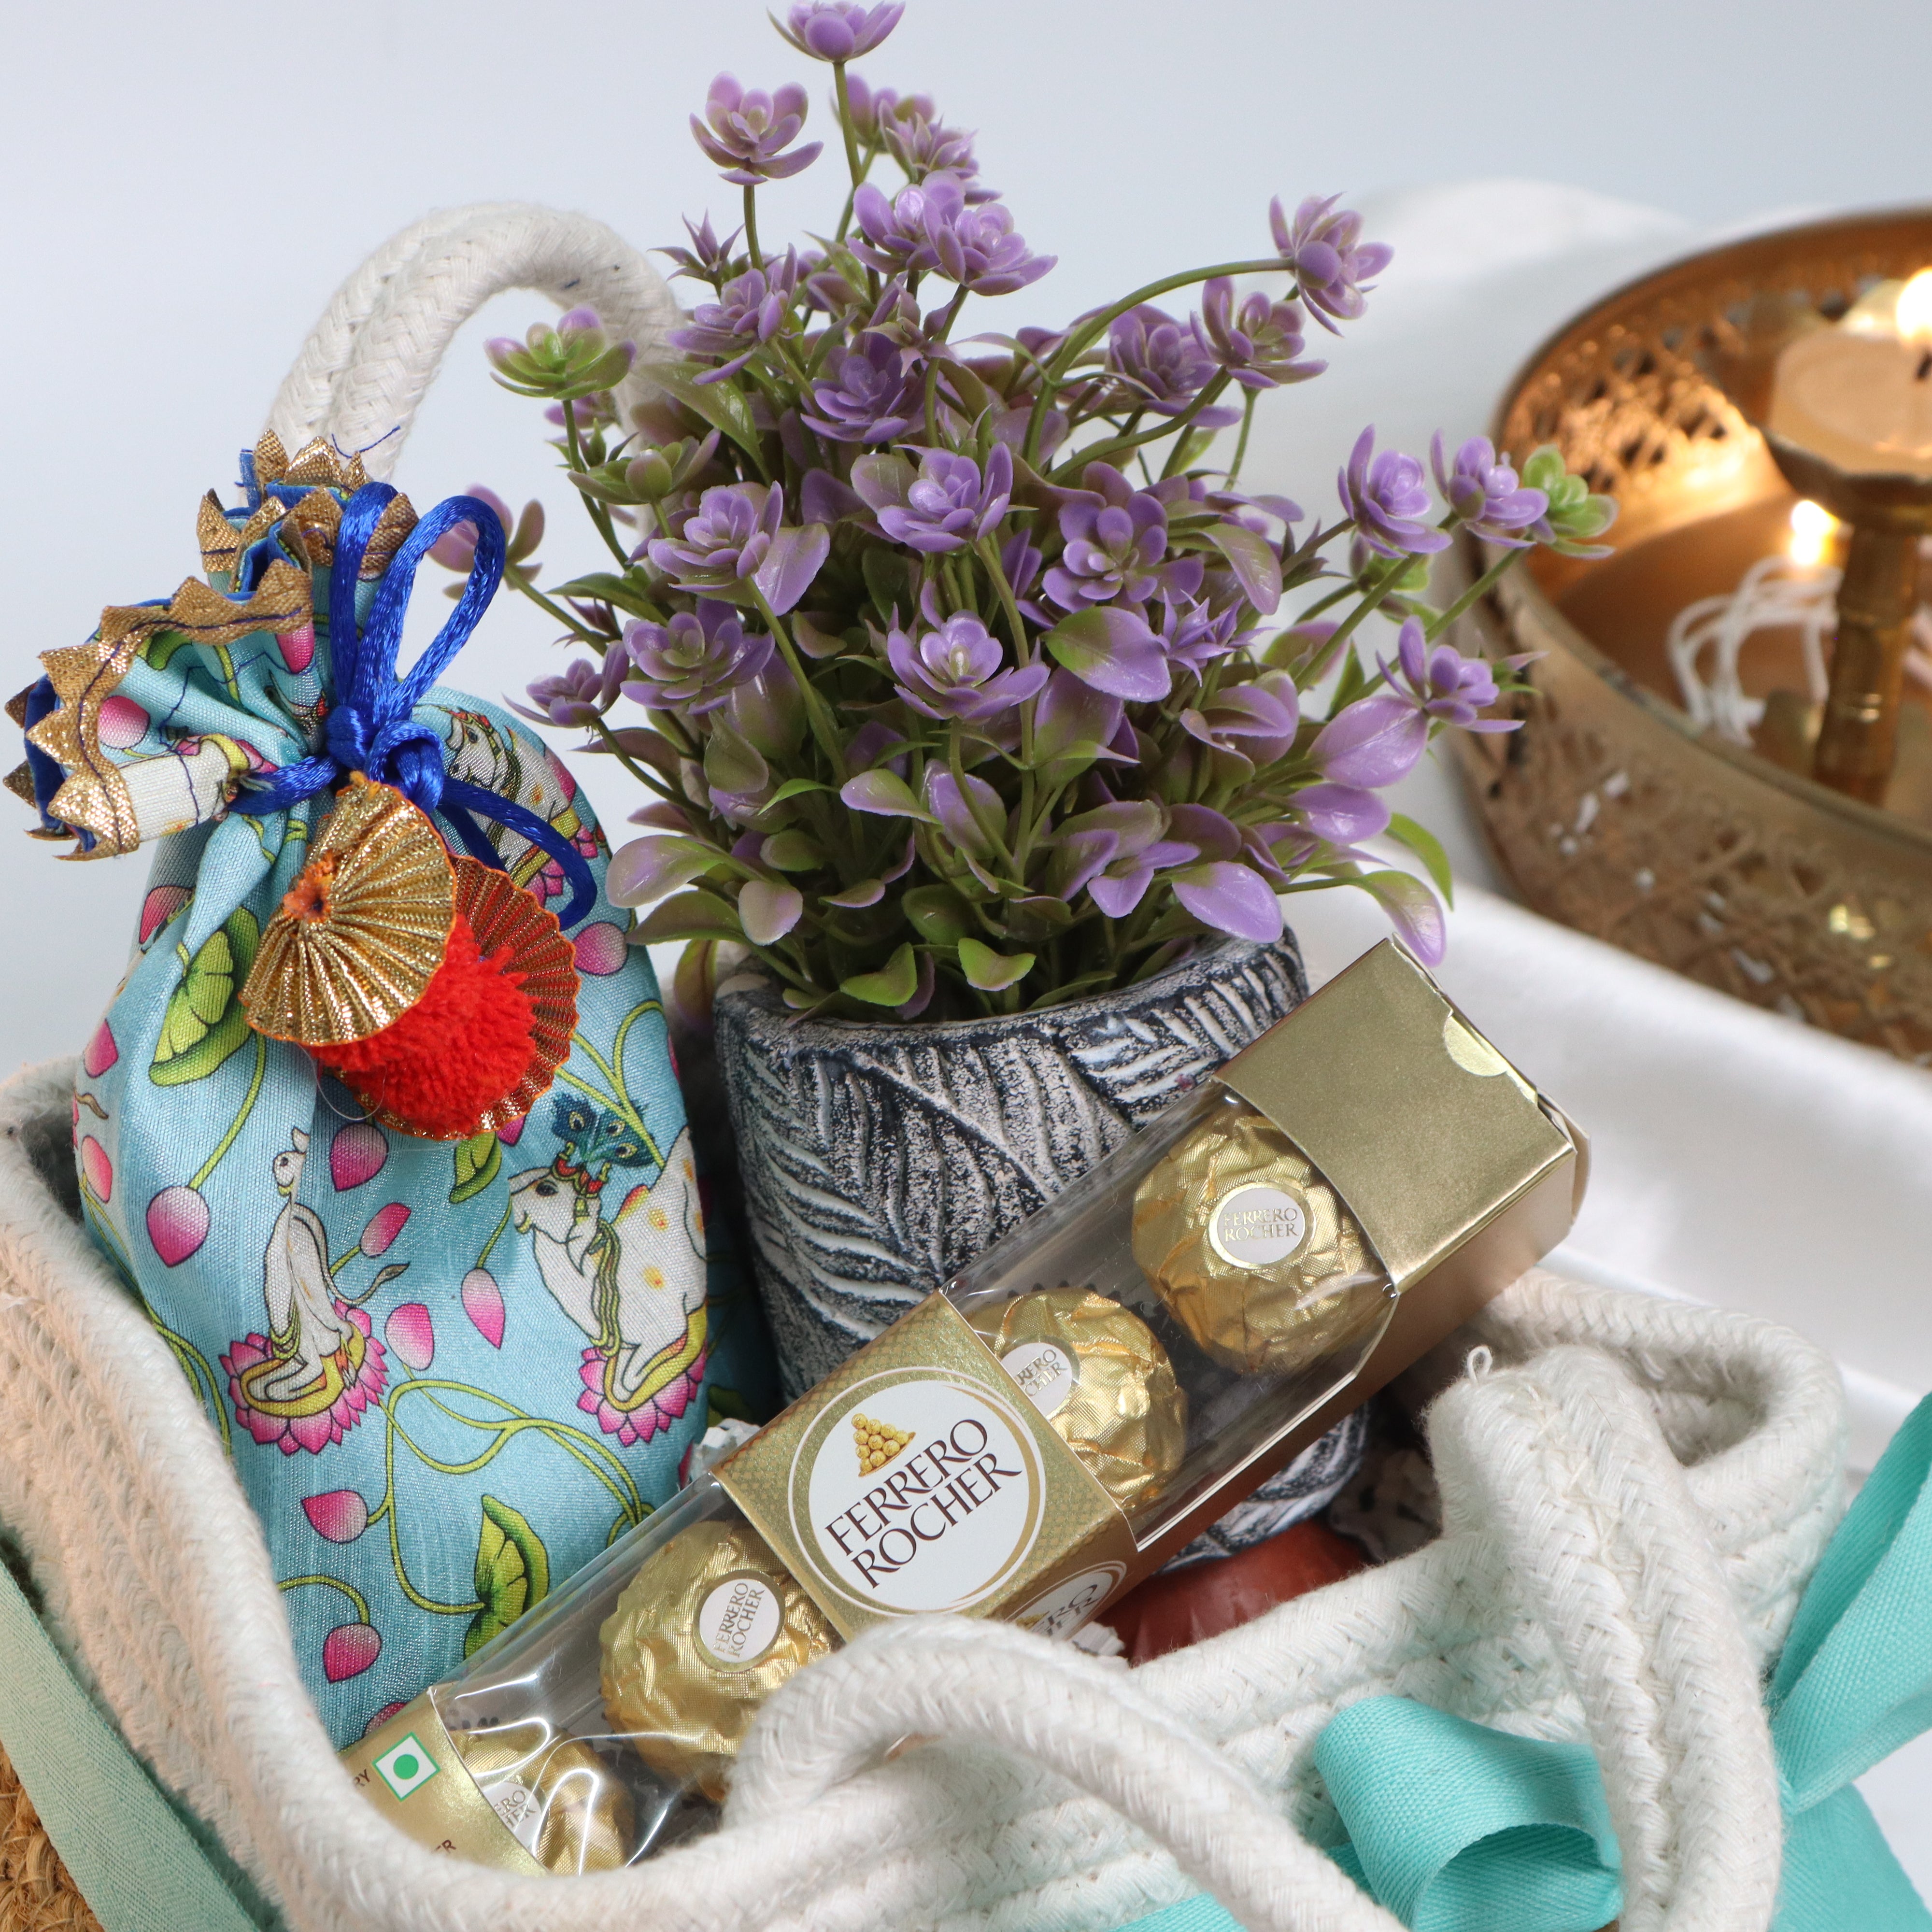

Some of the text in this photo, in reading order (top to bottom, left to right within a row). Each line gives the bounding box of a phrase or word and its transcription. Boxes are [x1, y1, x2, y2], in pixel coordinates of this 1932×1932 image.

[1223, 1208, 1297, 1228] FERRERO
[1224, 1222, 1299, 1242] ROCHER
[824, 1419, 988, 1557] FERRERO
[850, 1453, 1023, 1589] ROCHER
[712, 1582, 748, 1653] FERRERO
[726, 1589, 765, 1658] ROCHER
